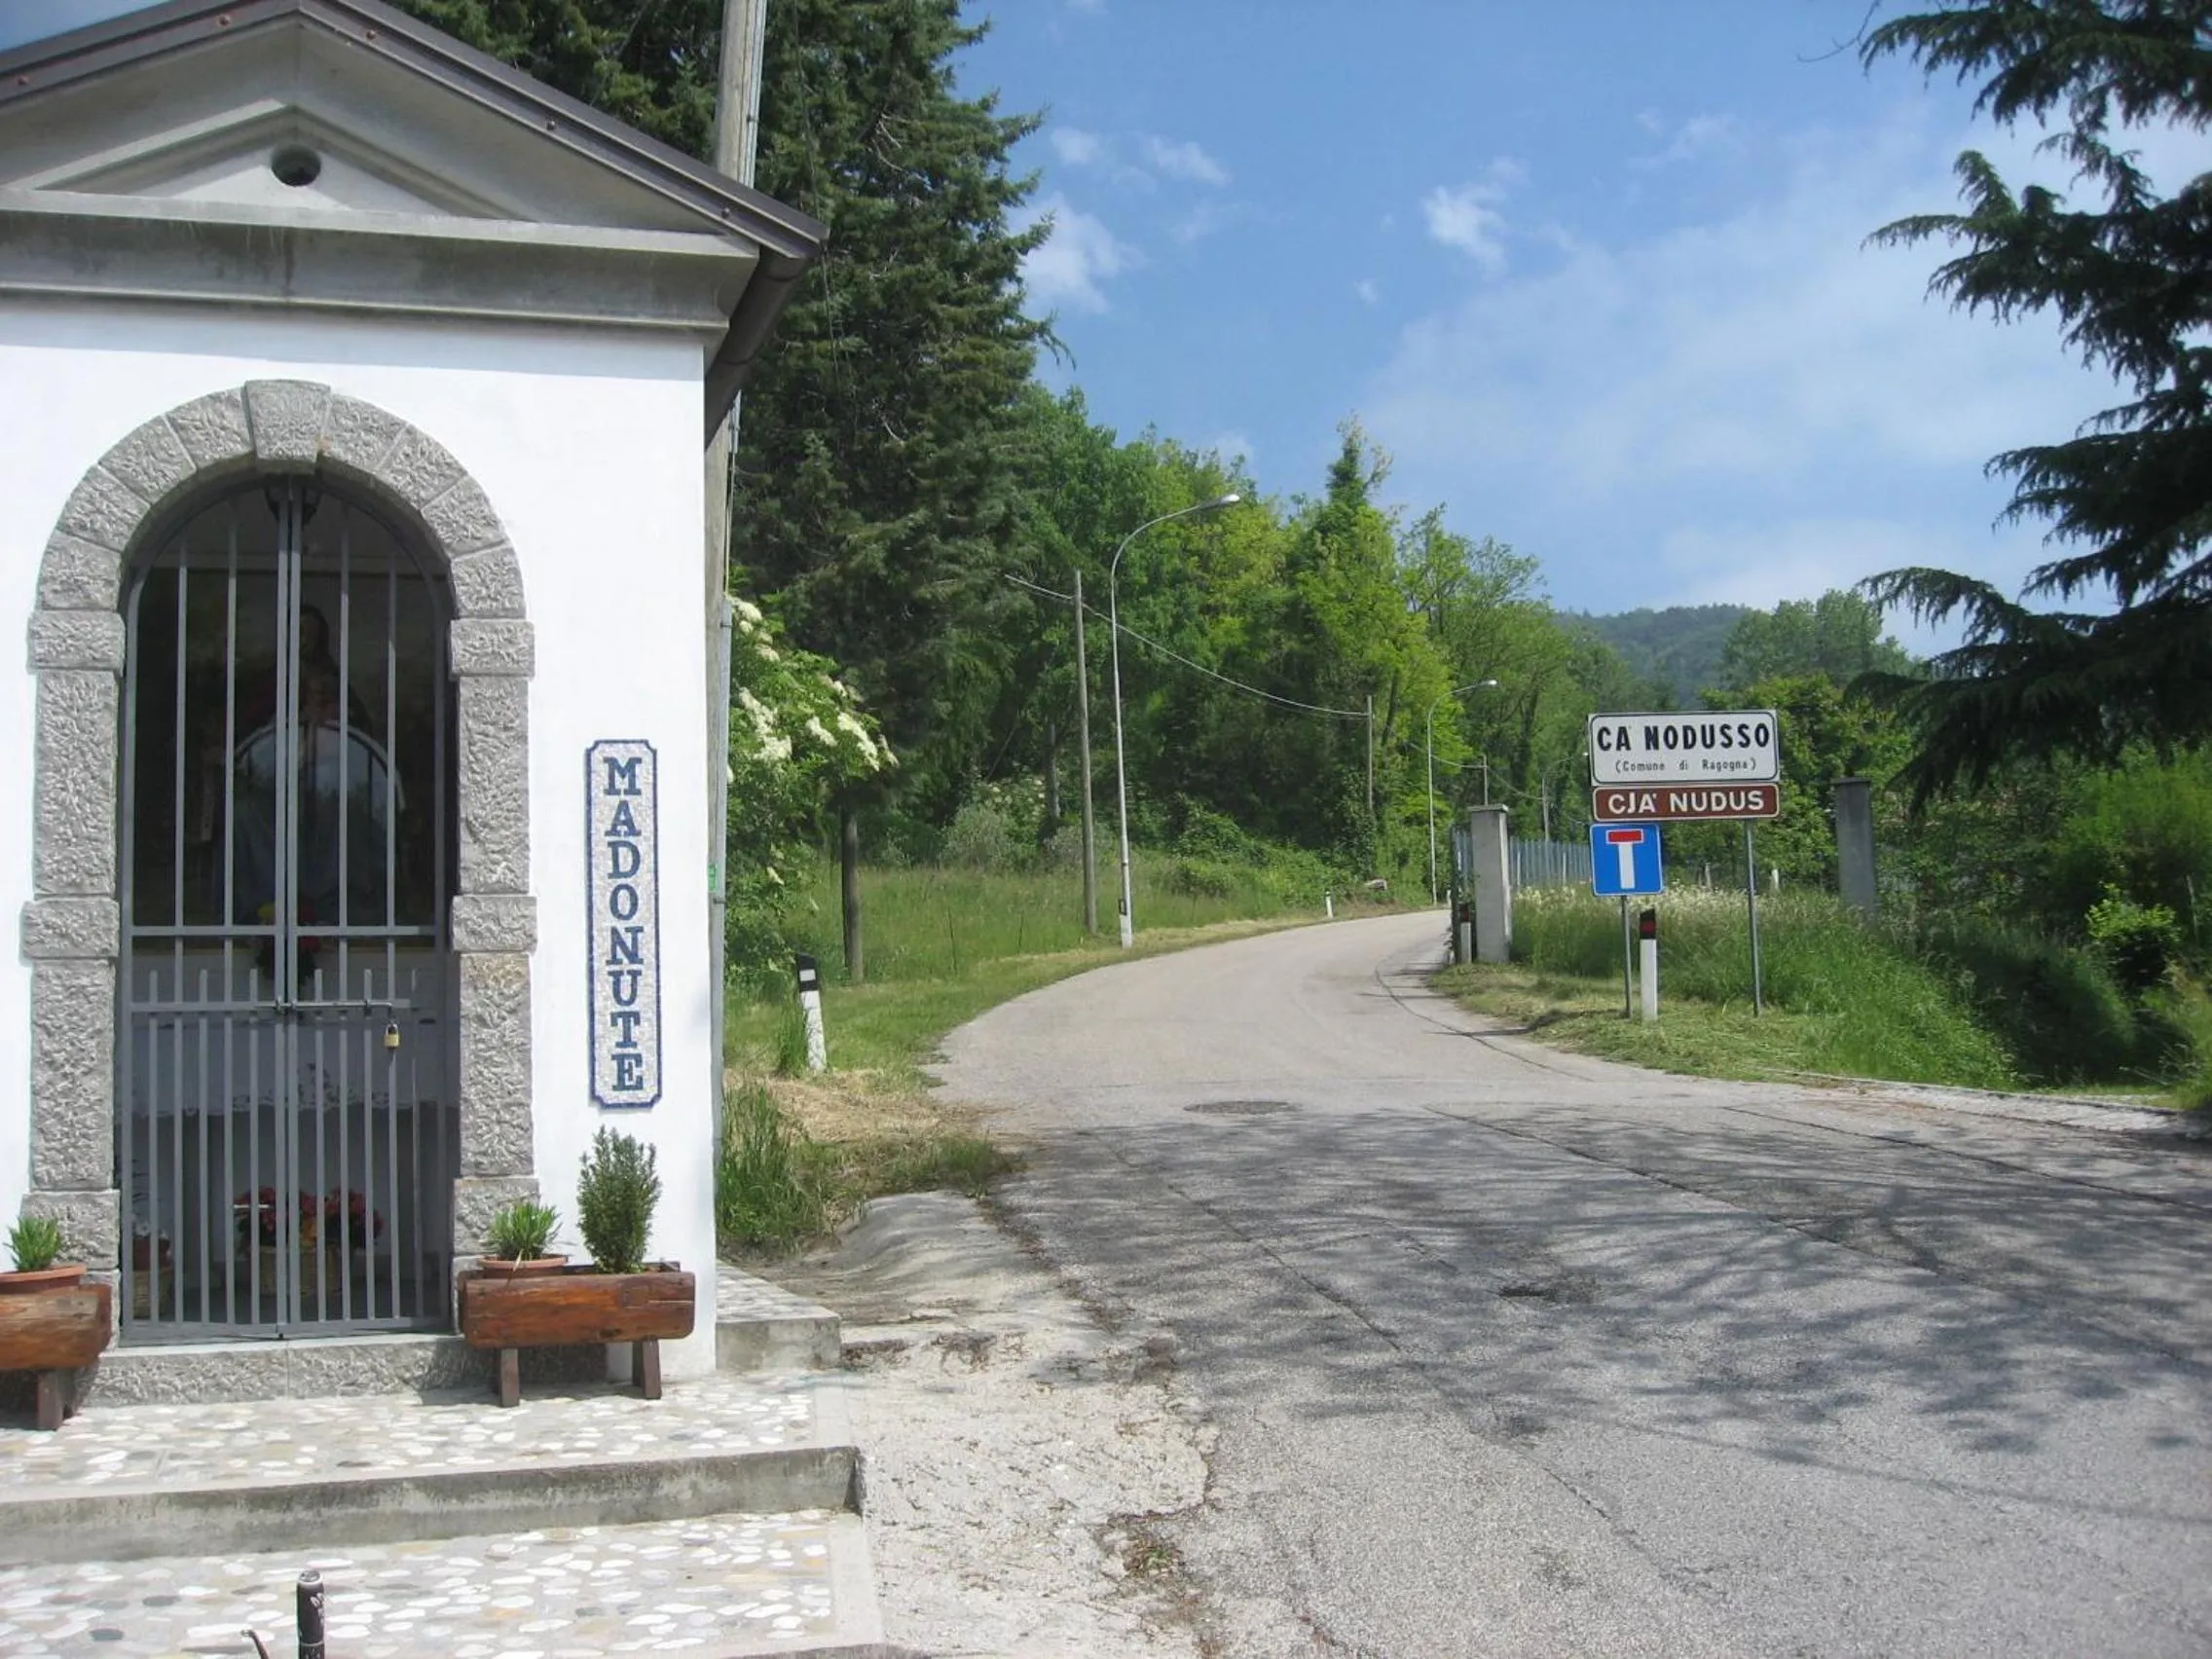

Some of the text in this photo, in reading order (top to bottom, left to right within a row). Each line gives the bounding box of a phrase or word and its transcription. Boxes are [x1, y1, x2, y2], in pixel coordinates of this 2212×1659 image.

[1644, 723, 1770, 752] NODUSSO
[1614, 756, 1757, 774] (Comune di Ragogna)
[1670, 790, 1764, 812] NUDUS
[603, 756, 644, 1092] MADONUTE
